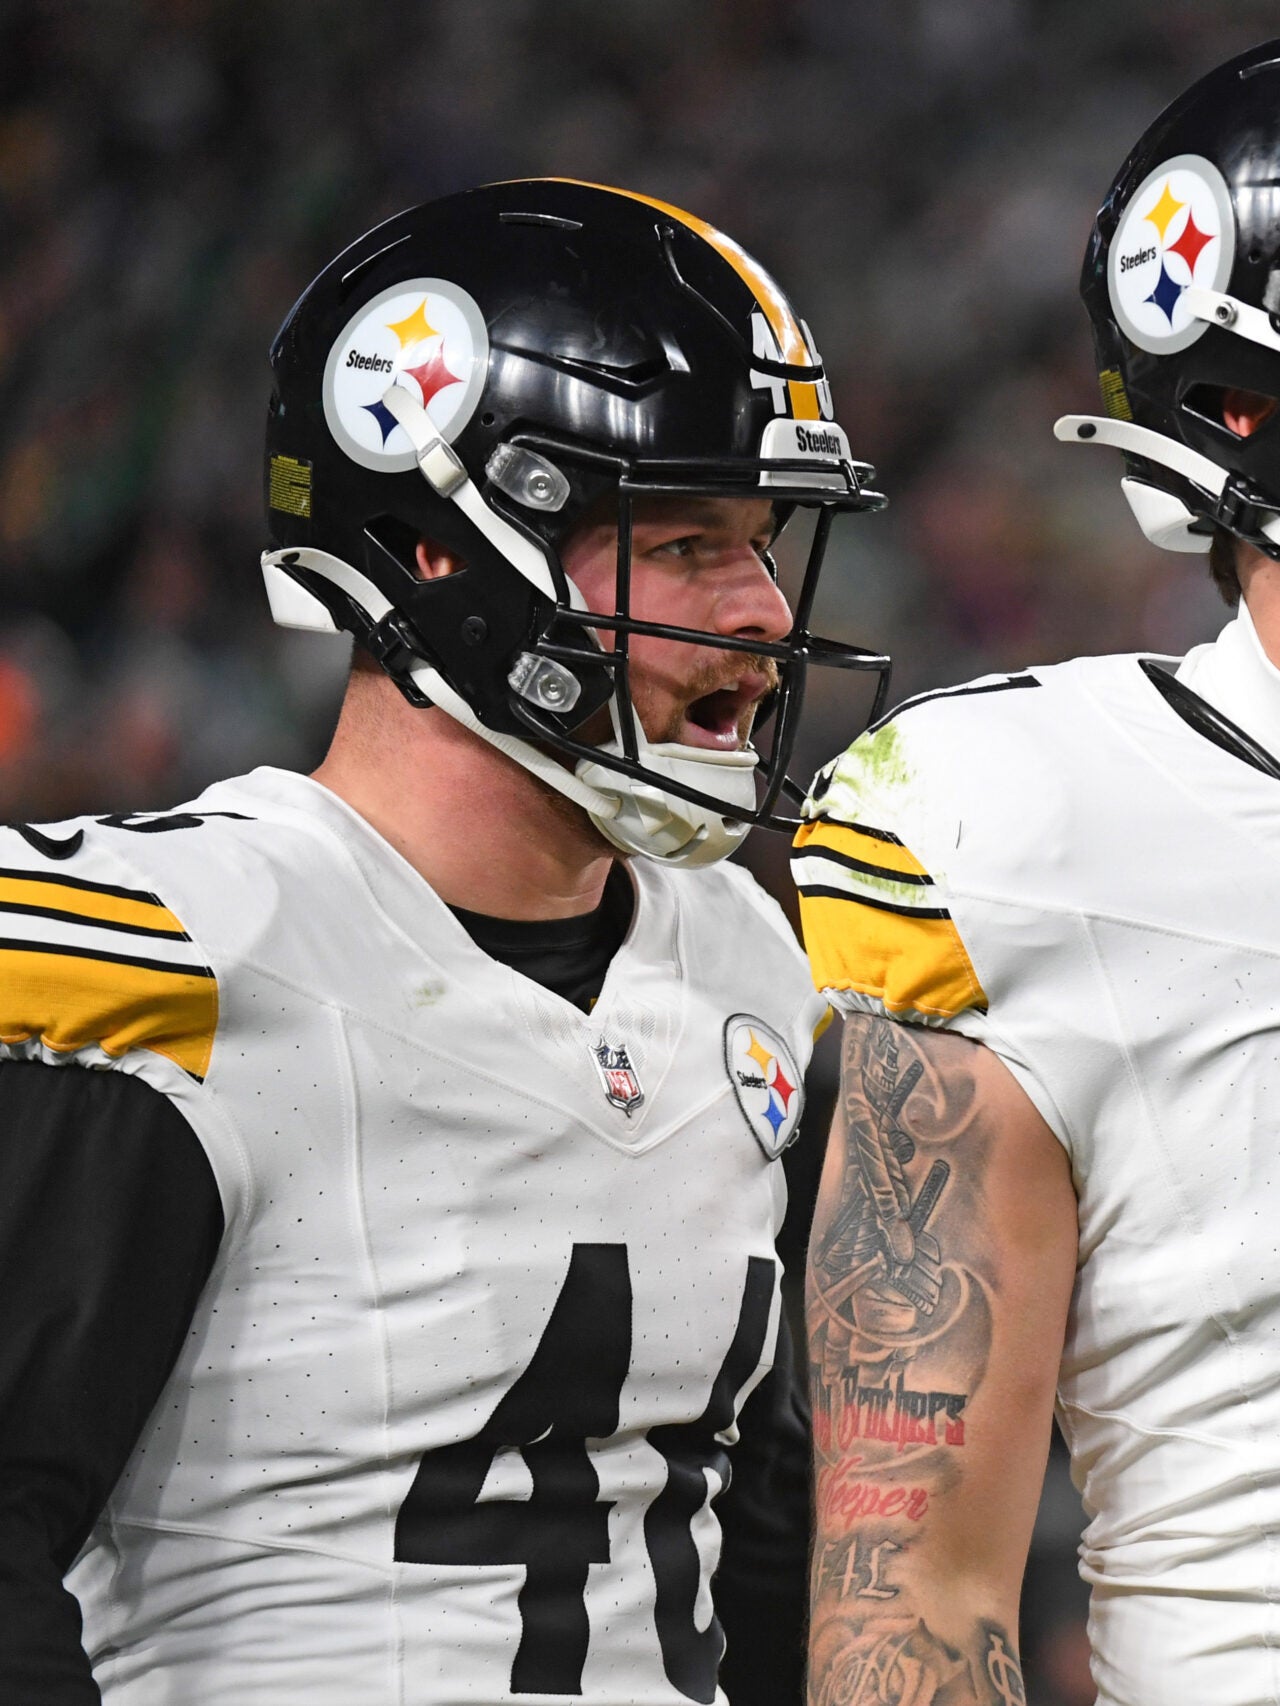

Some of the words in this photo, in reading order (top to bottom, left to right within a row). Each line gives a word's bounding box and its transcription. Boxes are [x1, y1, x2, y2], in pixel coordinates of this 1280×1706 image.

[1120, 246, 1156, 273] Steelers
[346, 349, 393, 373] Steelers
[795, 425, 842, 456] Steelers
[605, 1070, 640, 1100] NFL
